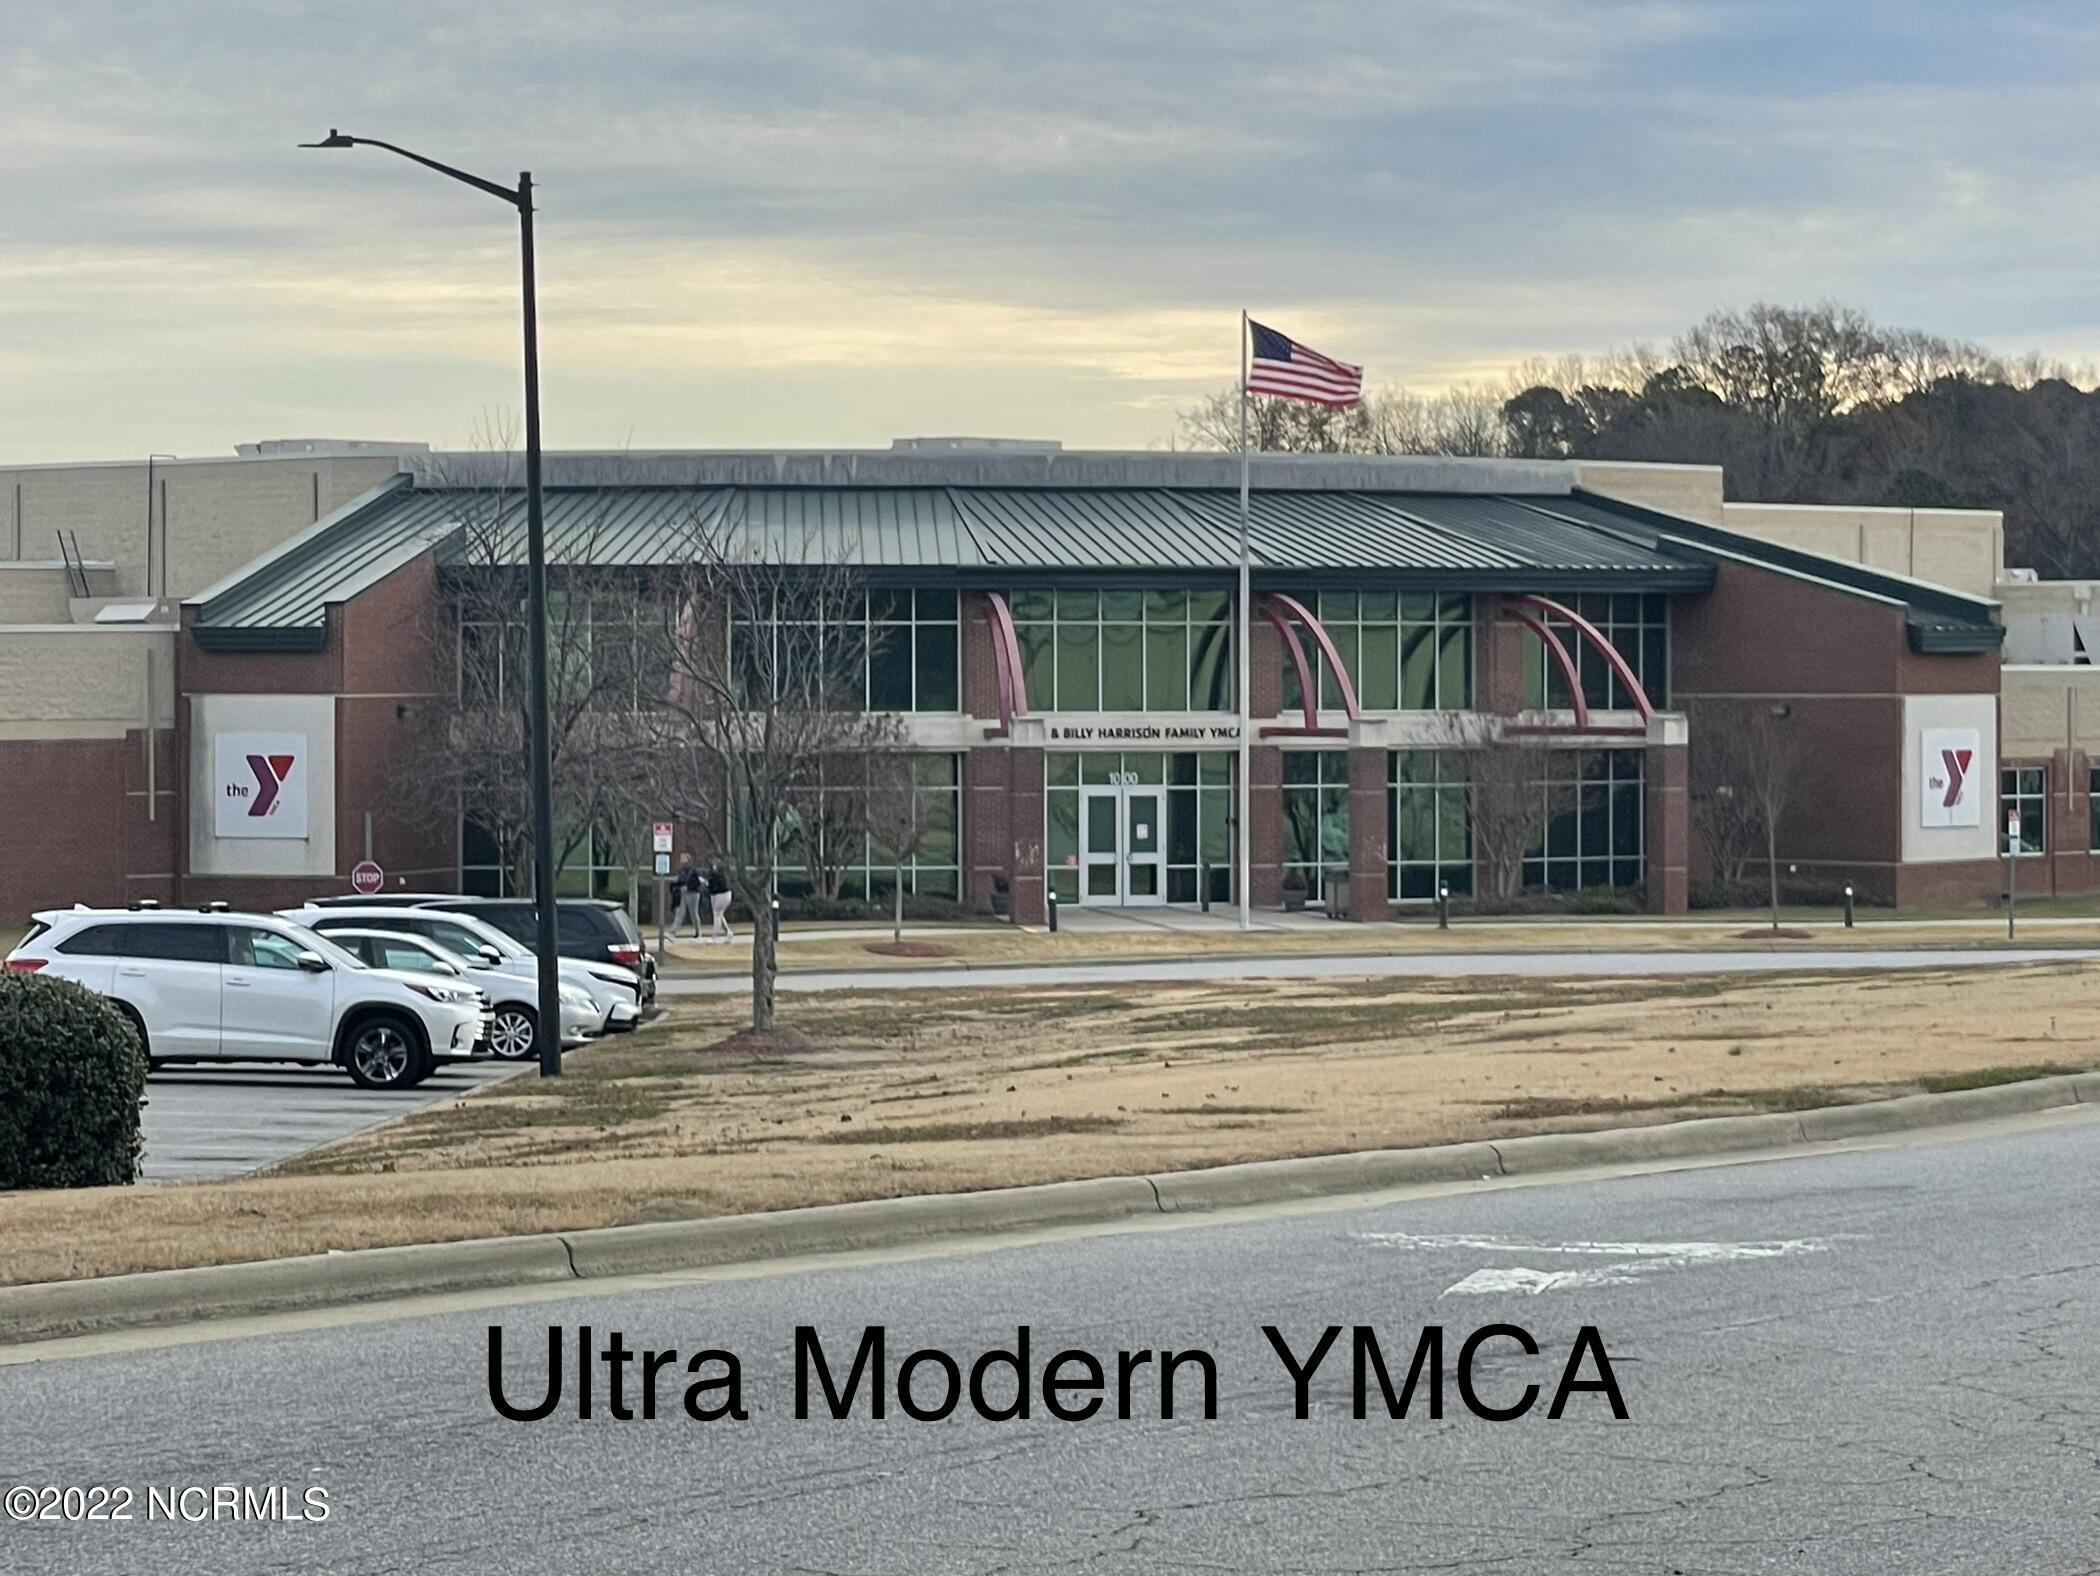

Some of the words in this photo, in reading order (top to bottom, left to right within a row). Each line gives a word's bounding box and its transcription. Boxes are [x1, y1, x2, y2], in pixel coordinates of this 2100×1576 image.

[1051, 727, 1059, 739] &
[1063, 727, 1093, 739] BILLY
[1098, 726, 1160, 739] HARRISON
[1165, 727, 1206, 739] FAMILY
[1929, 777, 1943, 789] the
[226, 783, 249, 797] the
[356, 872, 380, 884] STOP
